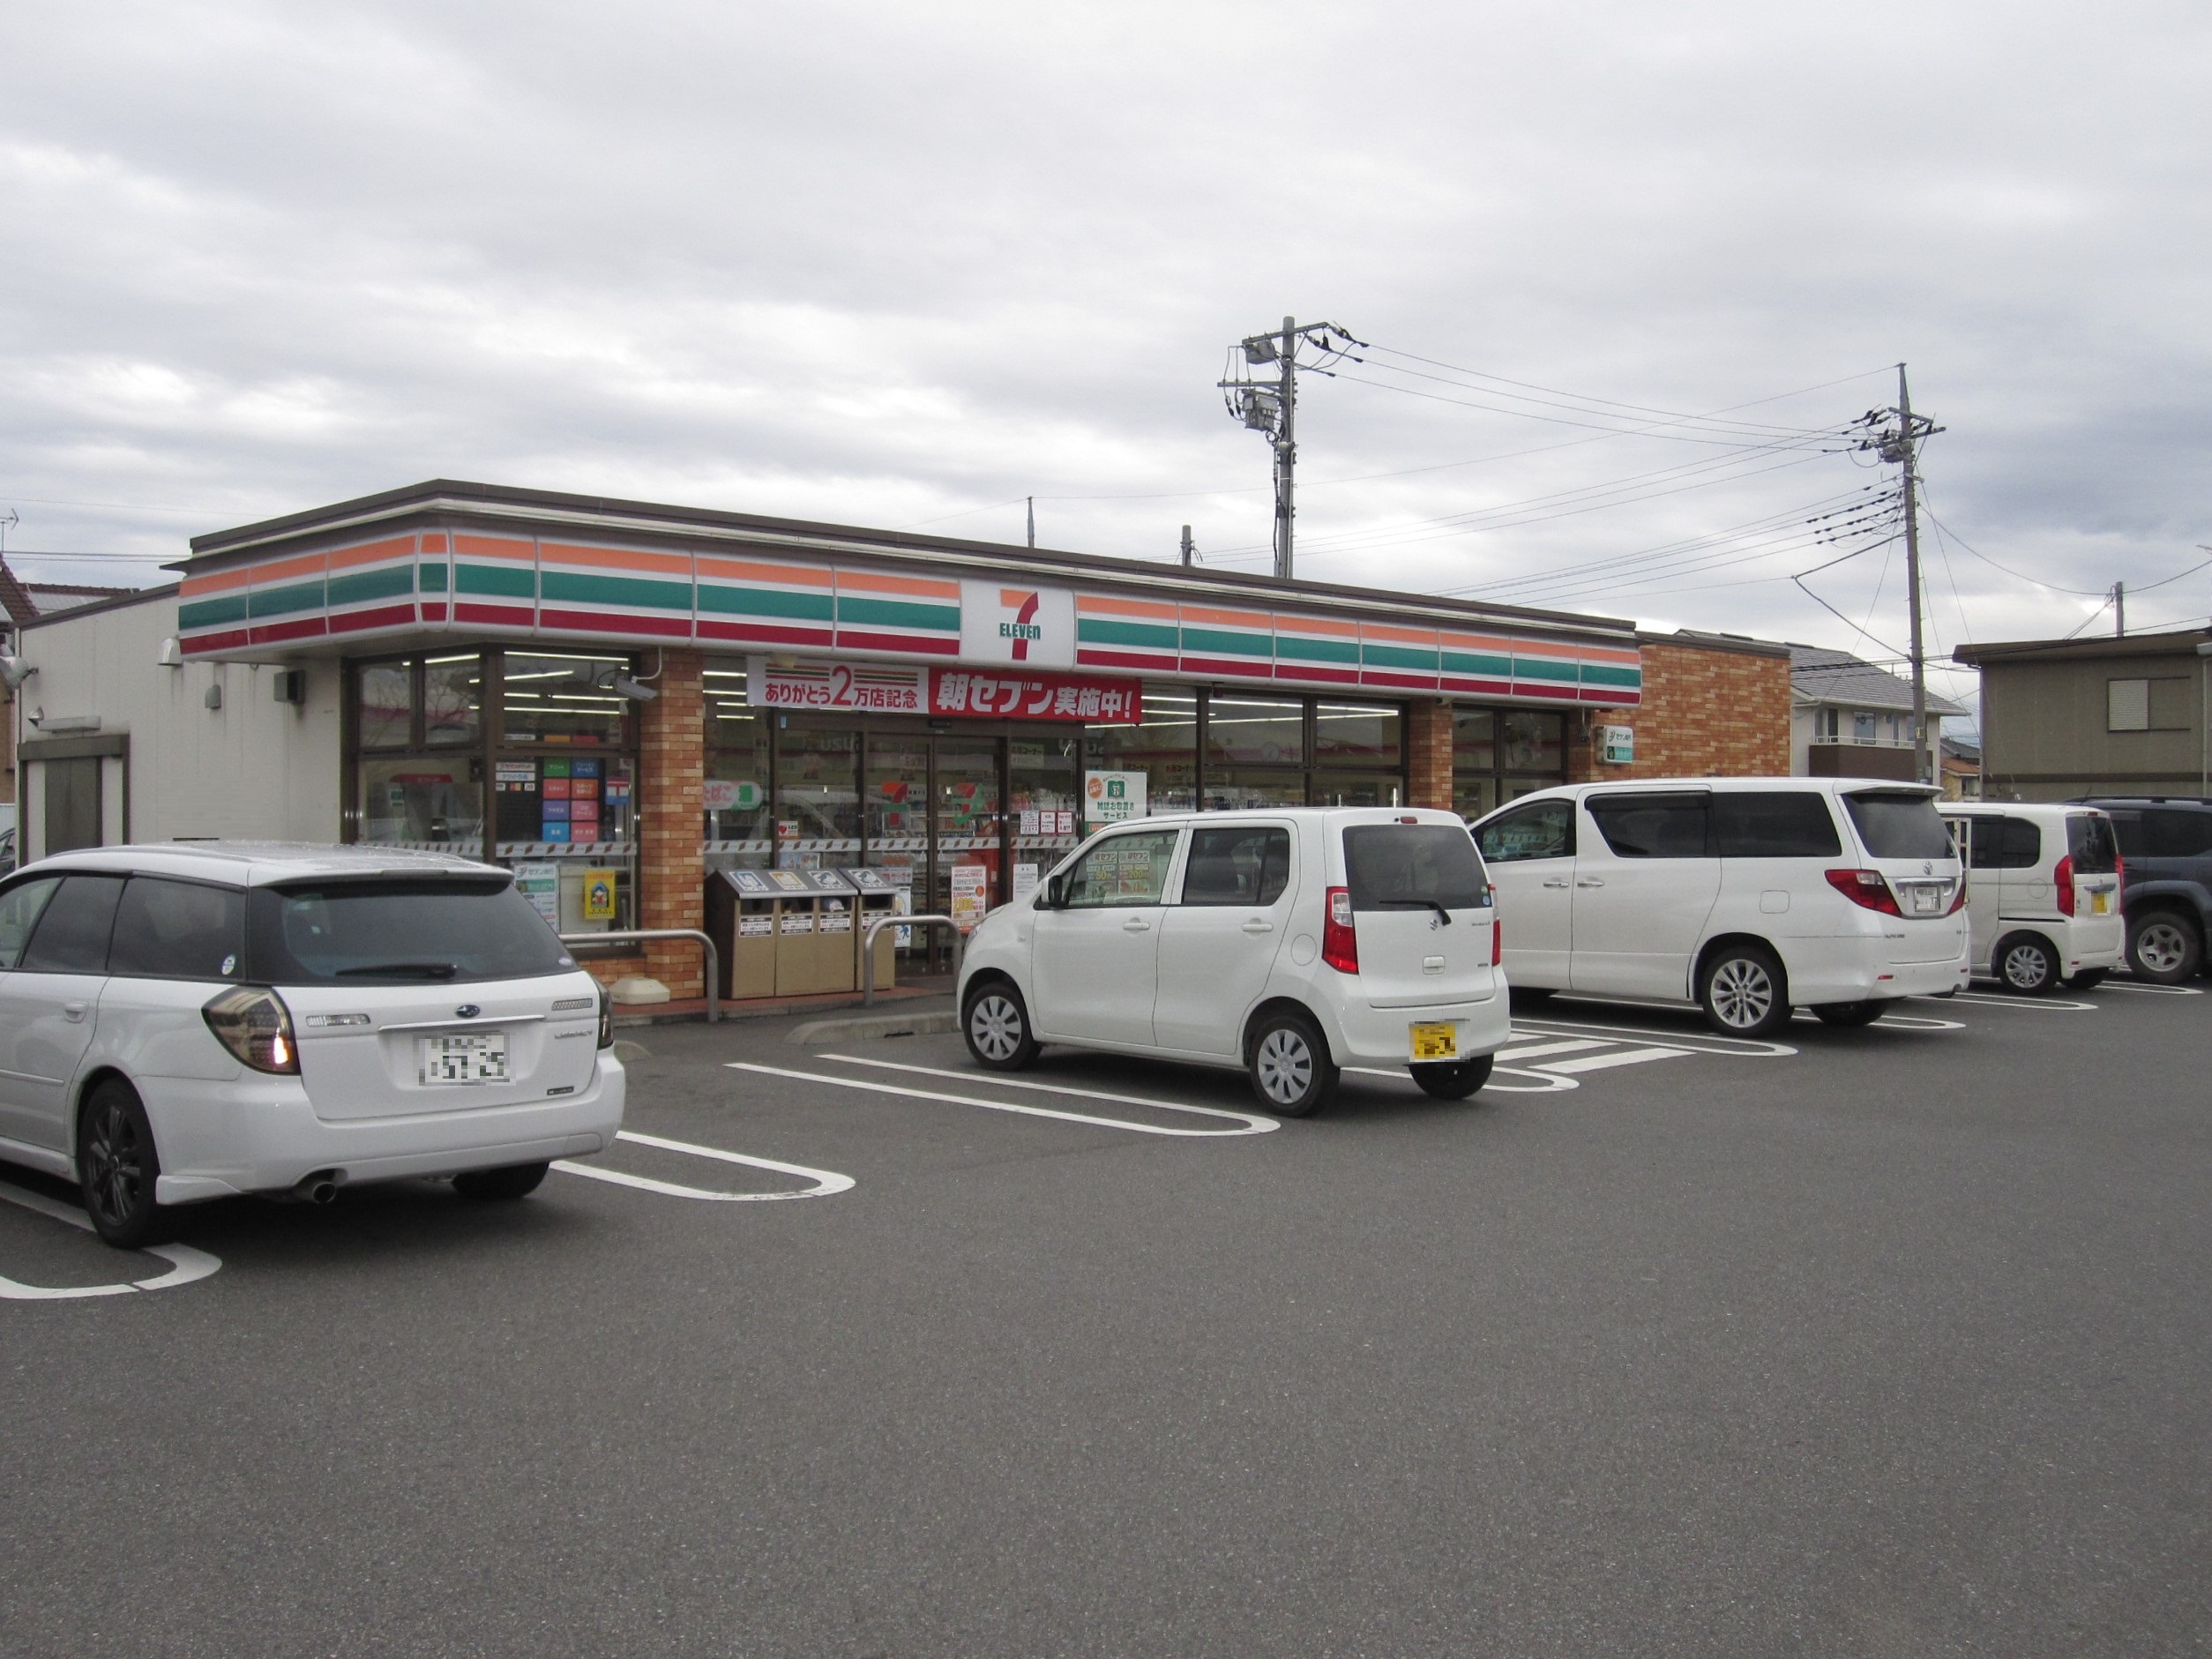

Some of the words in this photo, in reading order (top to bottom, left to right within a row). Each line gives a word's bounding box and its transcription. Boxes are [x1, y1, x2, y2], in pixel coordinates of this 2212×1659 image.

[998, 622, 1042, 640] ELEVEN
[999, 588, 1040, 661] 7
[765, 665, 918, 707] ありがとう2万店記念
[1102, 811, 1129, 820] サービス
